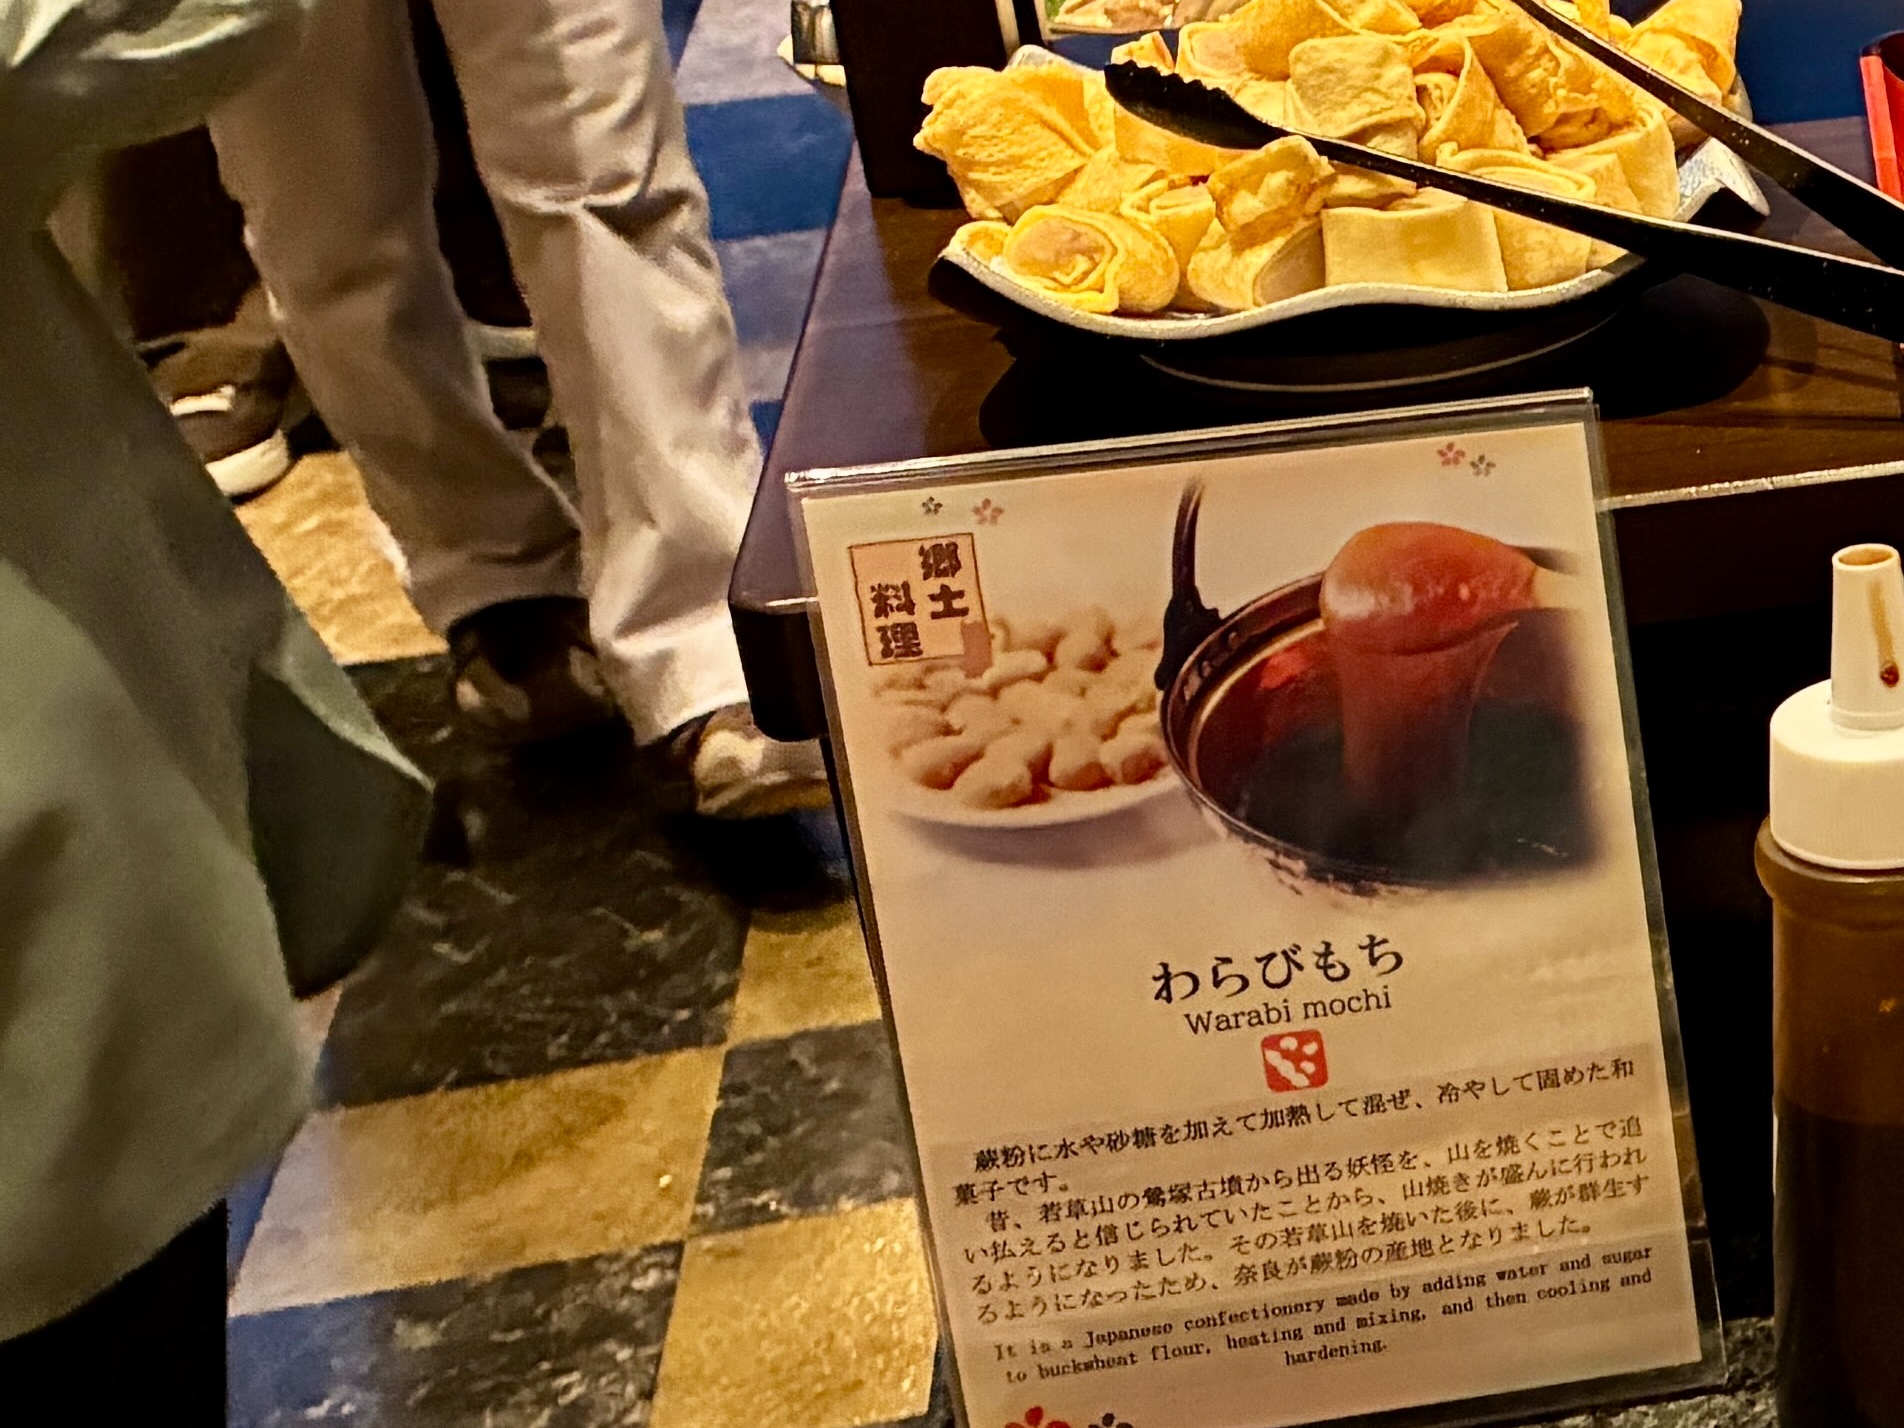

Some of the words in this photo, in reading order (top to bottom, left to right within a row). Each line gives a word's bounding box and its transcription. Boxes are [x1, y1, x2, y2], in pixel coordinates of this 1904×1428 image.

[1152, 933, 1403, 1004] わらびもち
[1184, 998, 1292, 1035] Warabi
[1303, 985, 1392, 1020] mochi
[955, 1170, 1069, 1207] 菓子です。
[965, 1146, 1647, 1264] い払えると信じられていたことから、山焼きが盛んに行われ
[977, 1214, 1590, 1324] るようになったため、奈良が蕨粉の産地となりました。
[995, 1343, 1016, 1362] It
[1031, 1339, 1051, 1355] is
[1061, 1338, 1073, 1350] a
[1084, 1320, 1174, 1348] Japanese
[1336, 1287, 1380, 1307] made
[1390, 1282, 1411, 1301] by
[1422, 1273, 1487, 1295] adding
[1495, 1262, 1549, 1282] water
[1559, 1254, 1592, 1272] and
[1602, 1246, 1653, 1267] sugar
[1006, 1367, 1028, 1384] to
[1037, 1351, 1139, 1381] buckwheat
[1226, 1324, 1304, 1350] heating
[1313, 1318, 1346, 1338] and
[1356, 1305, 1427, 1331] mixing,
[1441, 1297, 1474, 1316] and
[1486, 1291, 1527, 1310] then
[1536, 1275, 1611, 1302] cooling
[1620, 1267, 1653, 1287] and
[1284, 1335, 1388, 1368] hardening.
